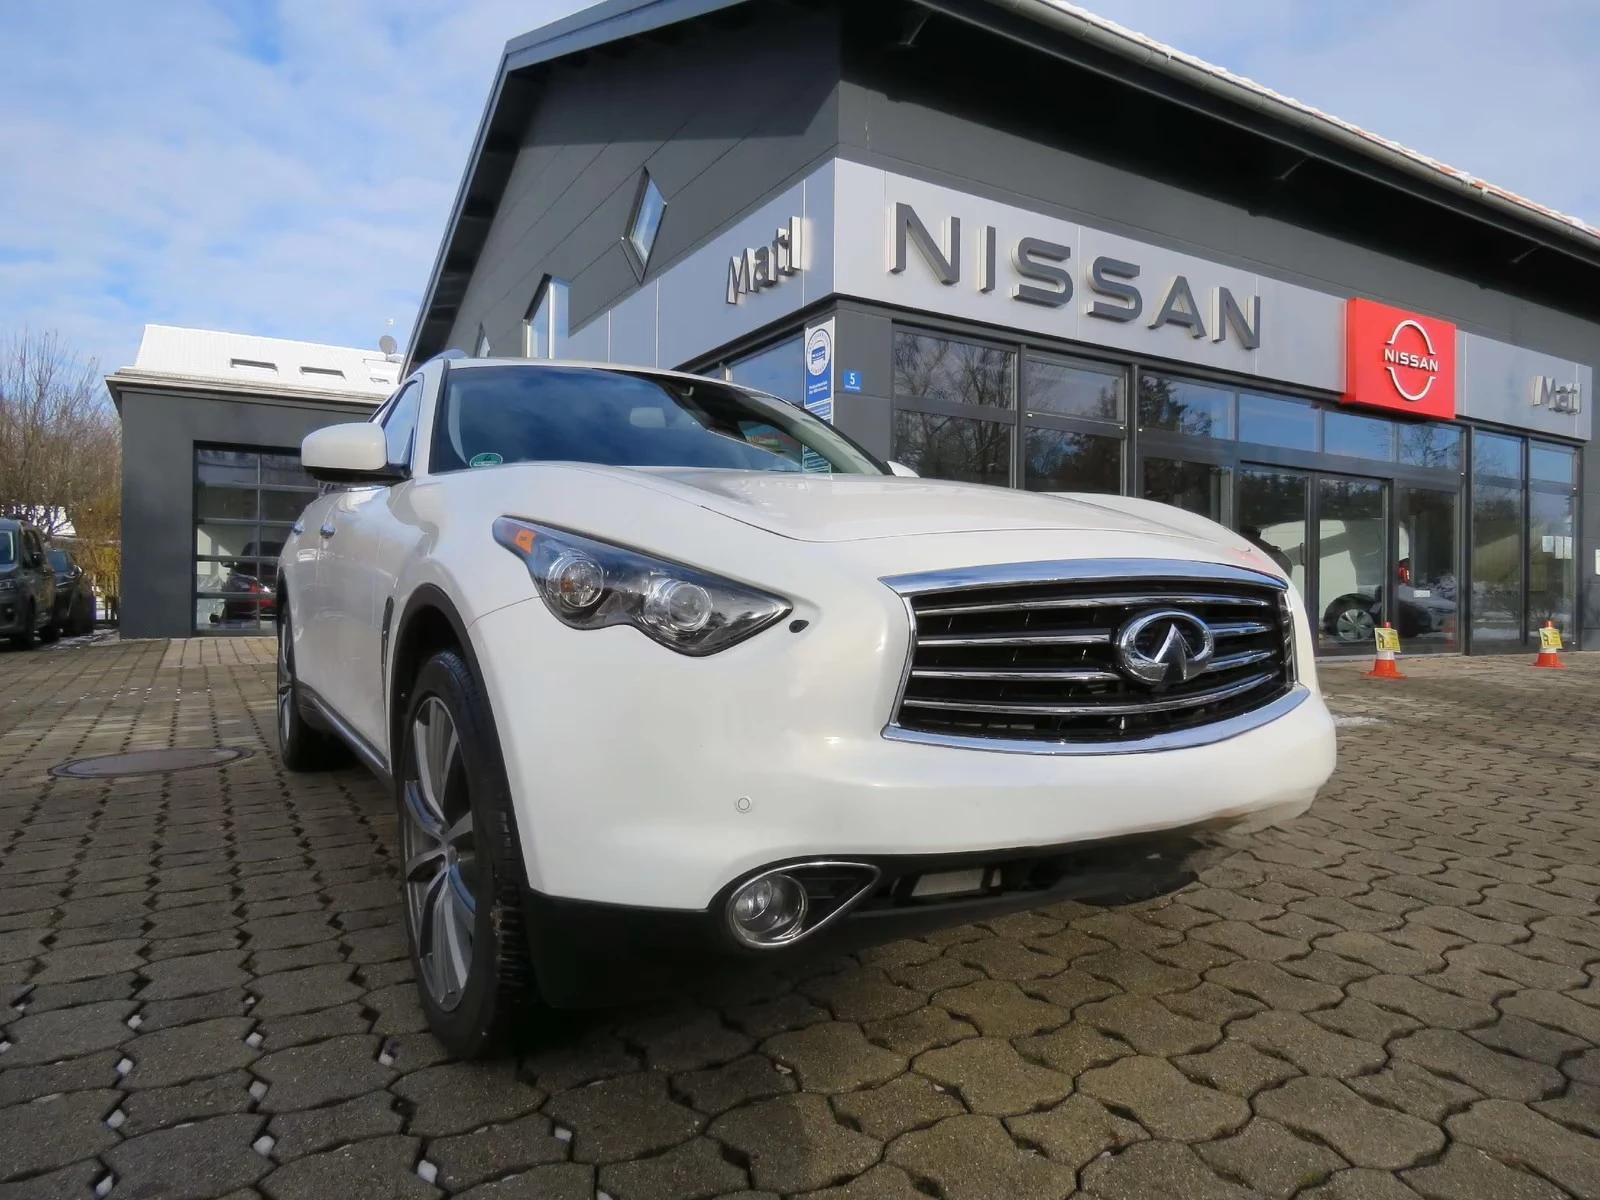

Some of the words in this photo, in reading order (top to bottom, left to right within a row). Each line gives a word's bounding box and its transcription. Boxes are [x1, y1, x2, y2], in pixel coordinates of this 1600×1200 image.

[890, 202, 1260, 350] NISSAN
[1384, 348, 1438, 372] NISSAN
[849, 373, 856, 385] 5
